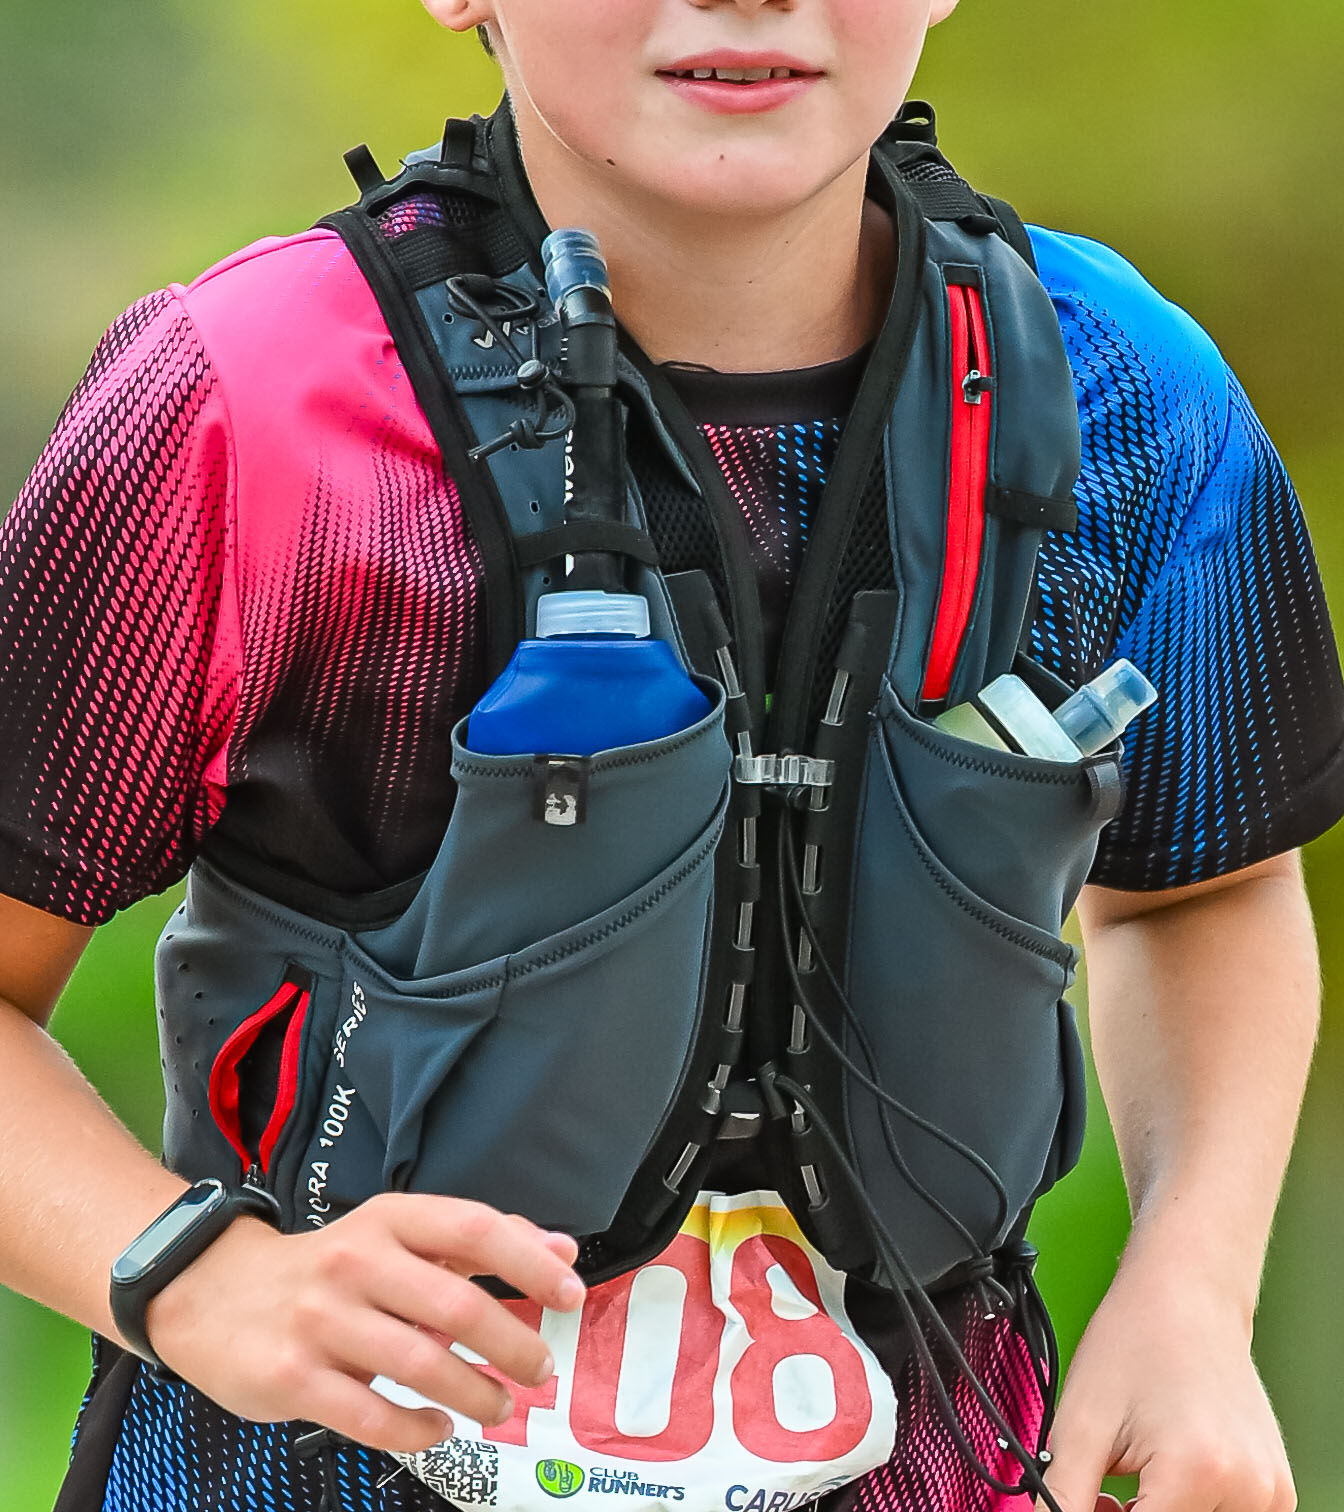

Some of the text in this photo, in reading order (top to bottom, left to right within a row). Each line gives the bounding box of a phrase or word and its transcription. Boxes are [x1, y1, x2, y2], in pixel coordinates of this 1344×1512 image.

[333, 981, 367, 1068] SERIES
[320, 1085, 356, 1148] 100K
[589, 1466, 639, 1481] CLUB
